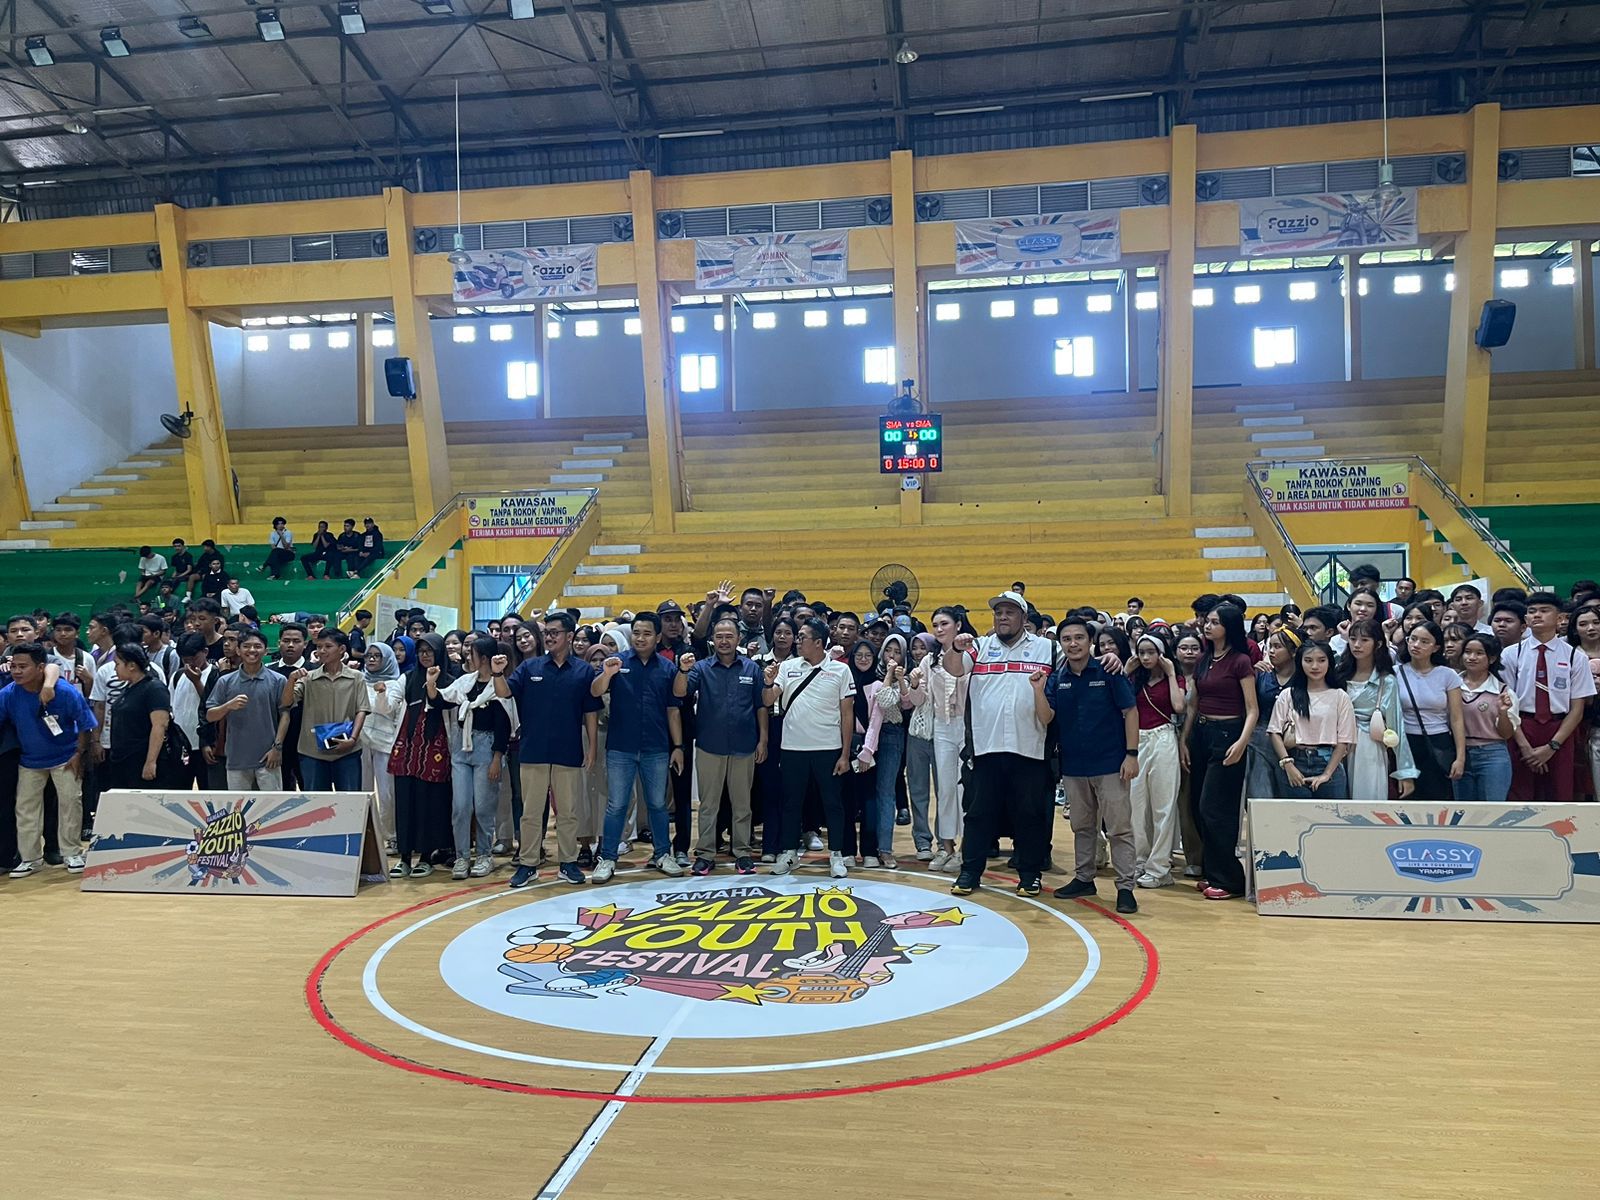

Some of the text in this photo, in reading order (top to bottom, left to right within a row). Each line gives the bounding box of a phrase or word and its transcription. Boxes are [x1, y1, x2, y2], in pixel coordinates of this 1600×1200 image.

[1269, 215, 1319, 229] Fazzio
[1018, 235, 1059, 246] CLASSY
[533, 263, 574, 276] Fazzio
[884, 430, 902, 442] 00
[920, 429, 936, 440] 00
[898, 458, 926, 468] 15:00
[1299, 466, 1366, 478] KAWASAN
[1286, 479, 1312, 490] TANPA
[1315, 478, 1344, 488] ROKOK
[1350, 476, 1381, 486] VAPING
[1276, 486, 1390, 500] DI AREA DALAM GEDUNG INI
[501, 497, 556, 507] KAWASAN
[1293, 501, 1315, 510] KASIH
[1318, 500, 1342, 510] UNTUK
[1344, 500, 1366, 508] TIDAK
[1368, 499, 1405, 508] MEROKOK
[490, 508, 512, 517] TANPA
[513, 508, 536, 516] ROKOK
[542, 507, 567, 516] VAPING
[482, 518, 490, 526] DI
[491, 518, 508, 526] AREA
[510, 517, 534, 526] DALAM
[535, 516, 564, 526] GEDUNG
[472, 528, 494, 537] TERIMA
[496, 528, 514, 536] KASIH
[515, 528, 536, 536] UNTUK
[537, 527, 554, 535] TIDAK
[203, 812, 242, 838] FAZZIO
[197, 832, 244, 854] YOUTH
[197, 854, 229, 868] FESTIVAL
[1393, 848, 1474, 861] CLASSY
[658, 886, 765, 902] YAMAHA
[624, 893, 858, 921] FAZZIO
[573, 922, 870, 952] YOUTH
[565, 950, 774, 978] FESTIVAL
